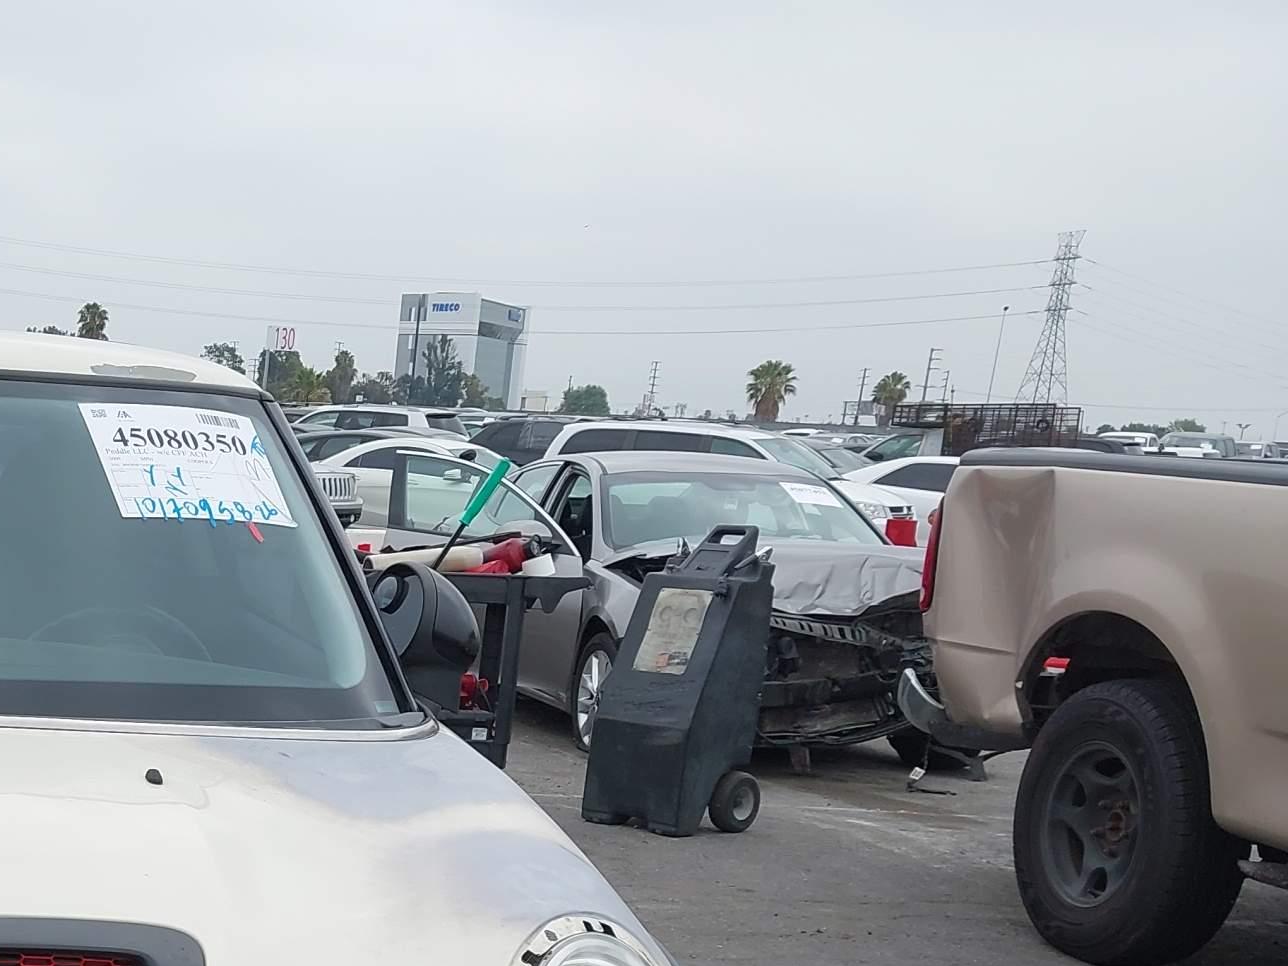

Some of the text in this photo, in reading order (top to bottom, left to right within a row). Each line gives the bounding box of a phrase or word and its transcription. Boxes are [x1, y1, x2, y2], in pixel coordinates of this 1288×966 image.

[432, 303, 461, 312] TIRECO
[275, 327, 296, 350] 130
[112, 427, 247, 456] 45080350
